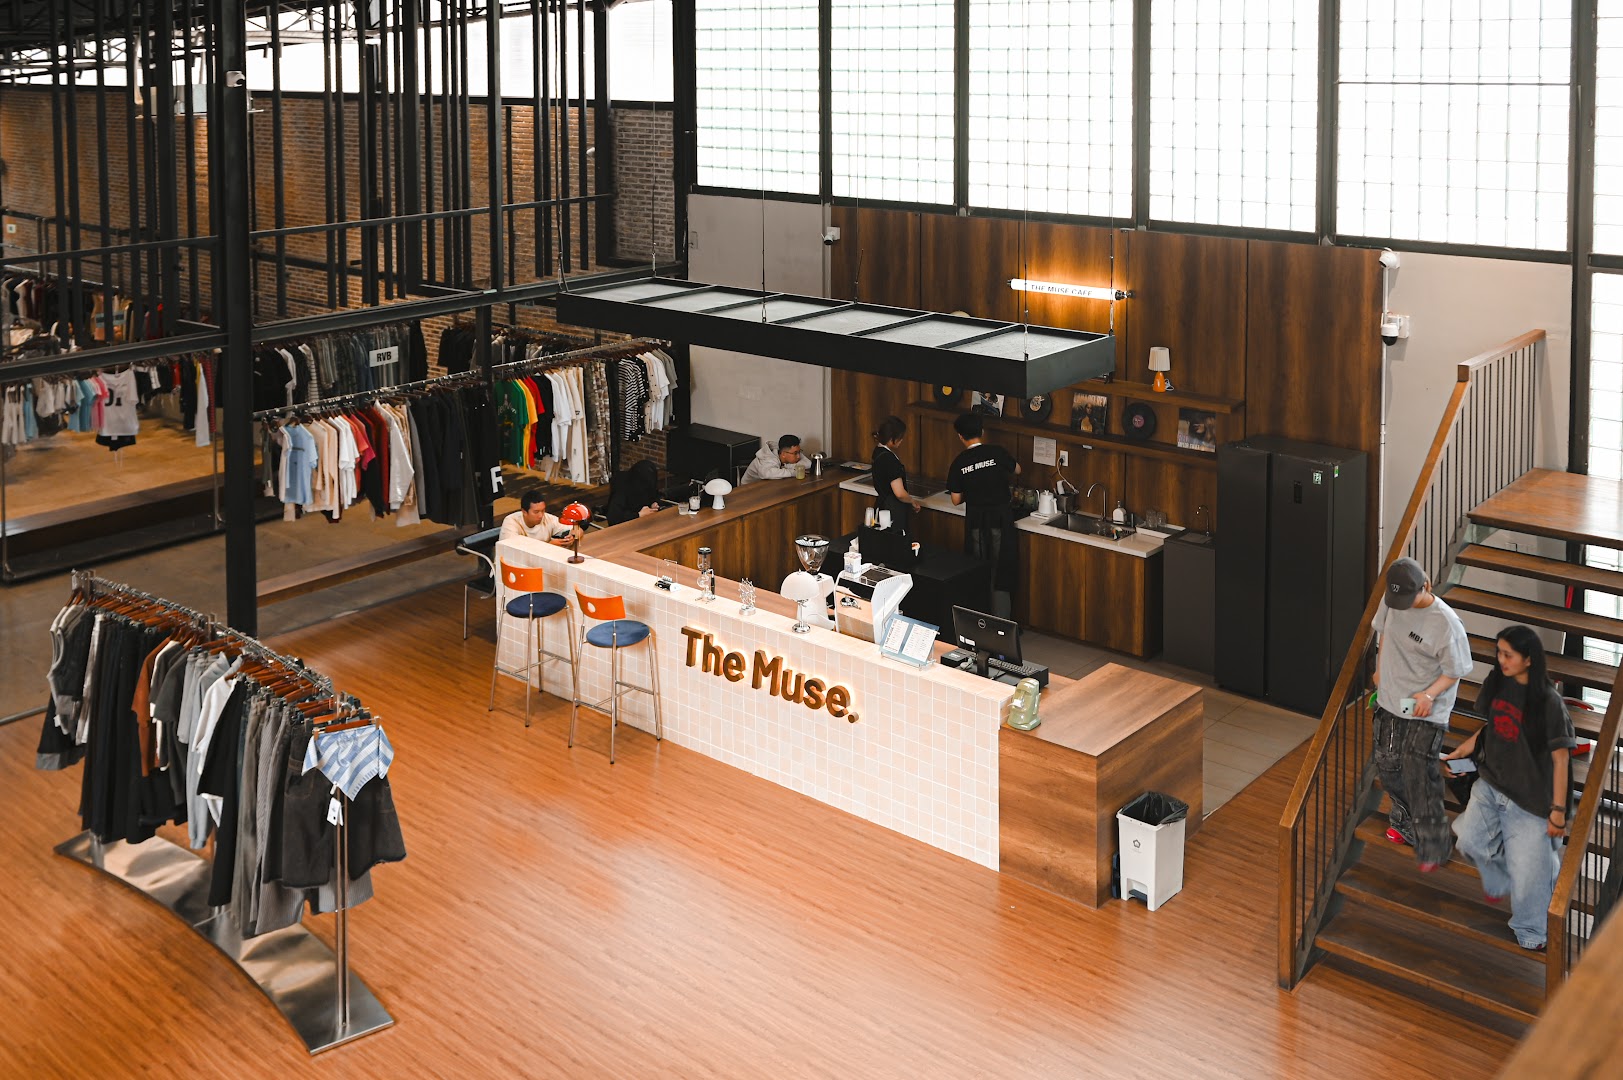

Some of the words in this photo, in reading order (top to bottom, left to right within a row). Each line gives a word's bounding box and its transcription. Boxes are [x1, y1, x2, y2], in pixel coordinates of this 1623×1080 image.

[1047, 286, 1070, 294] MUSE
[376, 351, 392, 362] RVB
[961, 464, 975, 475] THE
[975, 459, 996, 470] MUSE.
[680, 625, 746, 682] The
[751, 649, 859, 723] Muse.
